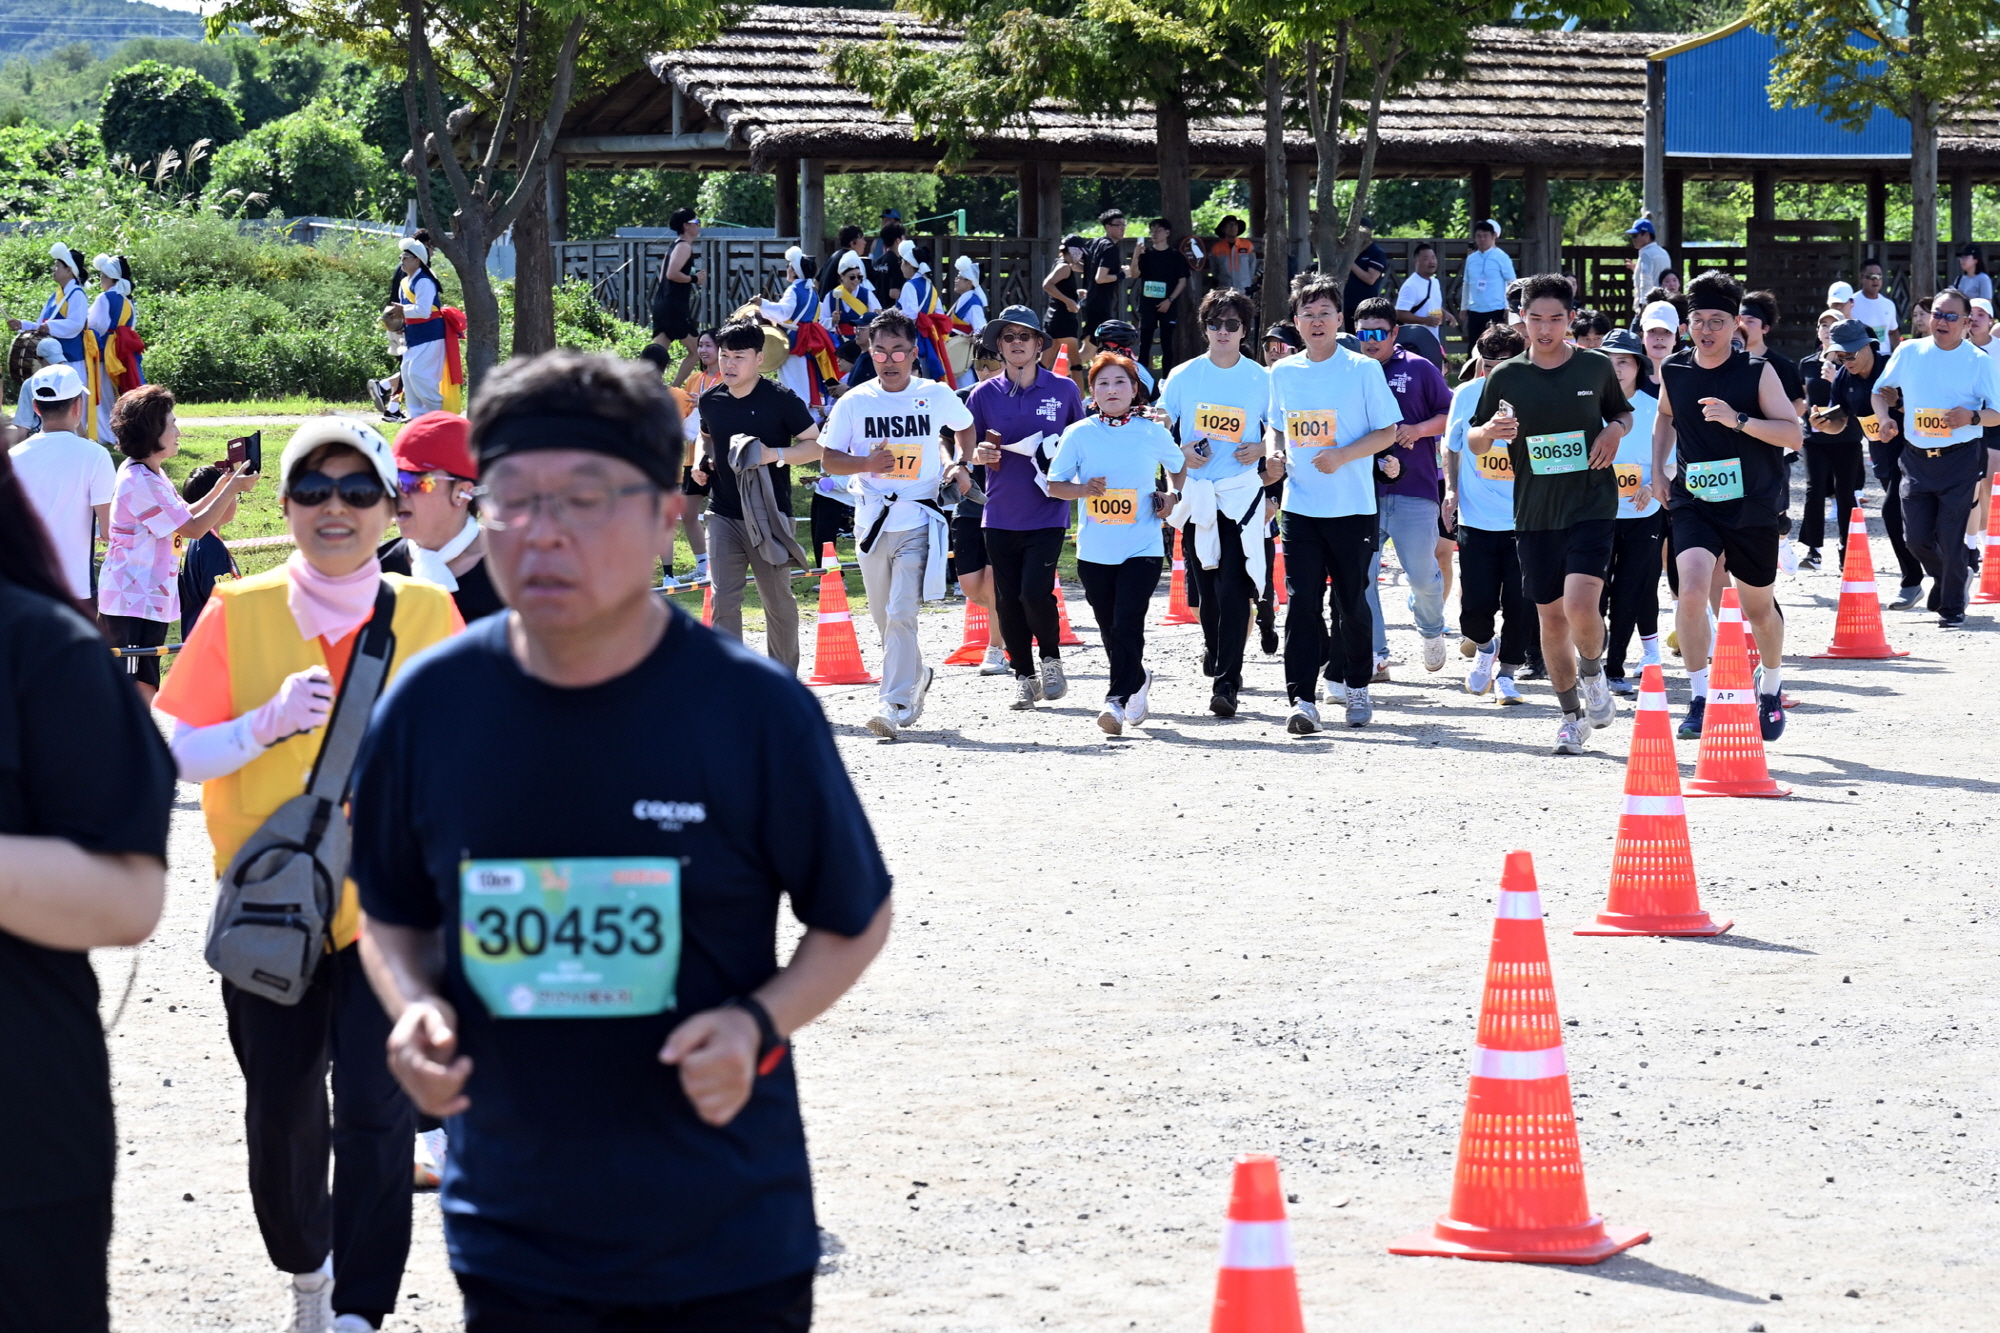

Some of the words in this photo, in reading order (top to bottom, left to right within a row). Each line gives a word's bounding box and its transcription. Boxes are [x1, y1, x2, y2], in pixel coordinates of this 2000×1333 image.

[865, 414, 930, 438] ANSAN
[1200, 414, 1240, 433] 1029
[1292, 420, 1329, 437] 1001
[1532, 442, 1583, 460] 30639
[896, 455, 917, 470] 17
[1688, 470, 1737, 489] 30201
[1091, 498, 1132, 515] 1009
[476, 905, 664, 957] 30453
